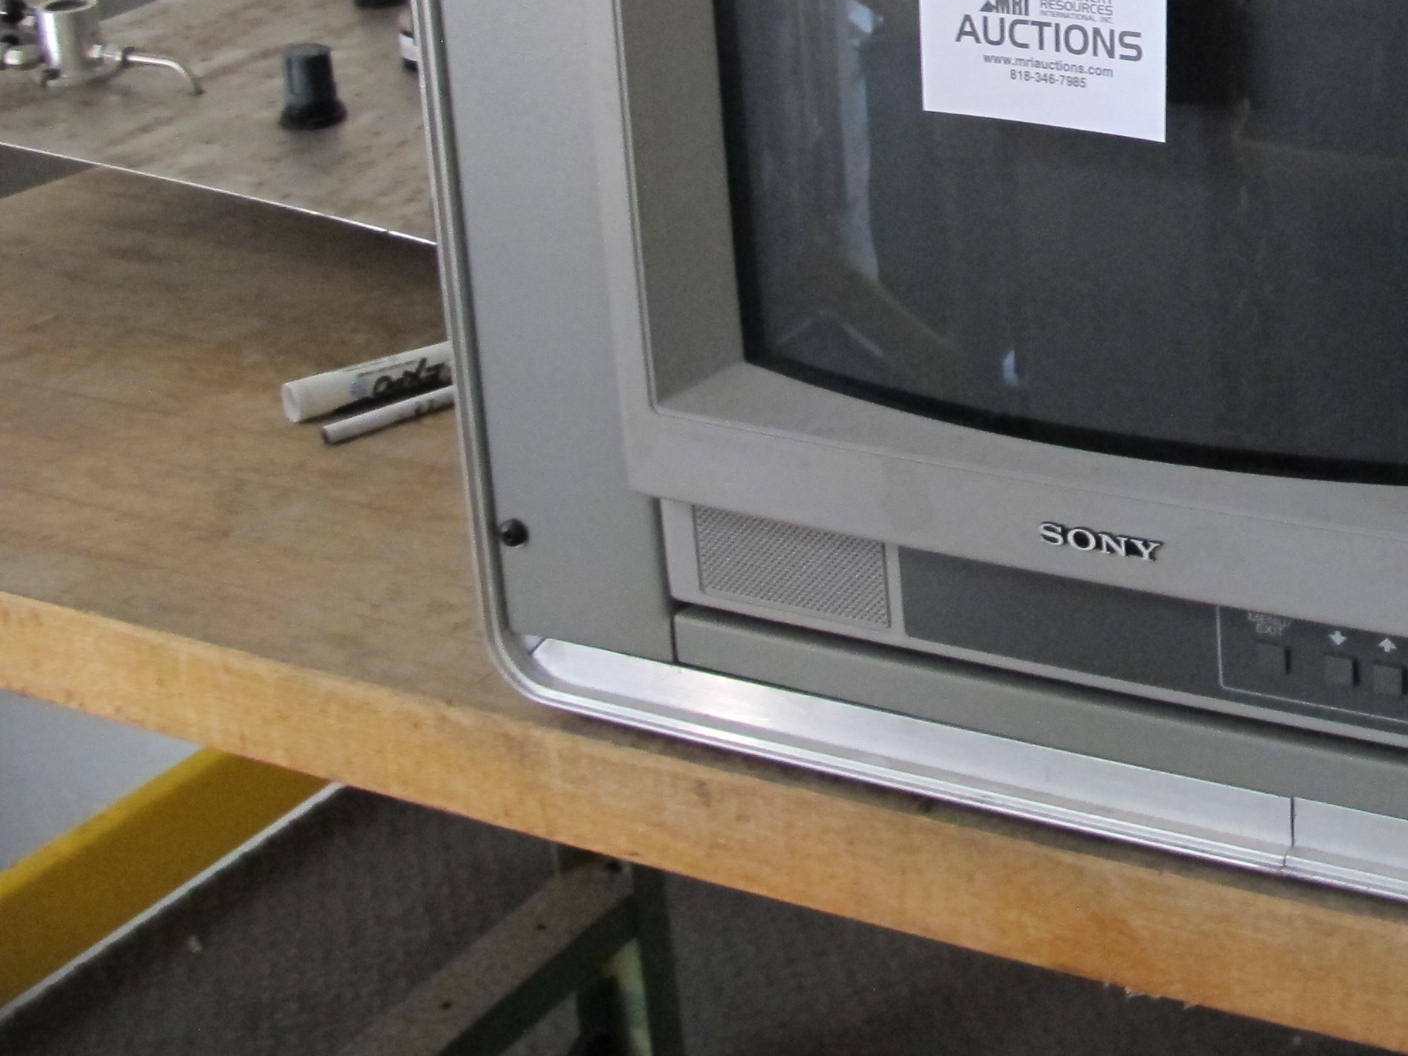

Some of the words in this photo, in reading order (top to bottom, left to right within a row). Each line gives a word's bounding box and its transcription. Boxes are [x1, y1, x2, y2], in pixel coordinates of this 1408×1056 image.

[1040, 0, 1114, 16] RESOURCES
[955, 14, 1143, 62] AUCTIONS
[983, 53, 1114, 78] www.mriauctions.com
[1039, 521, 1162, 562] SONY
